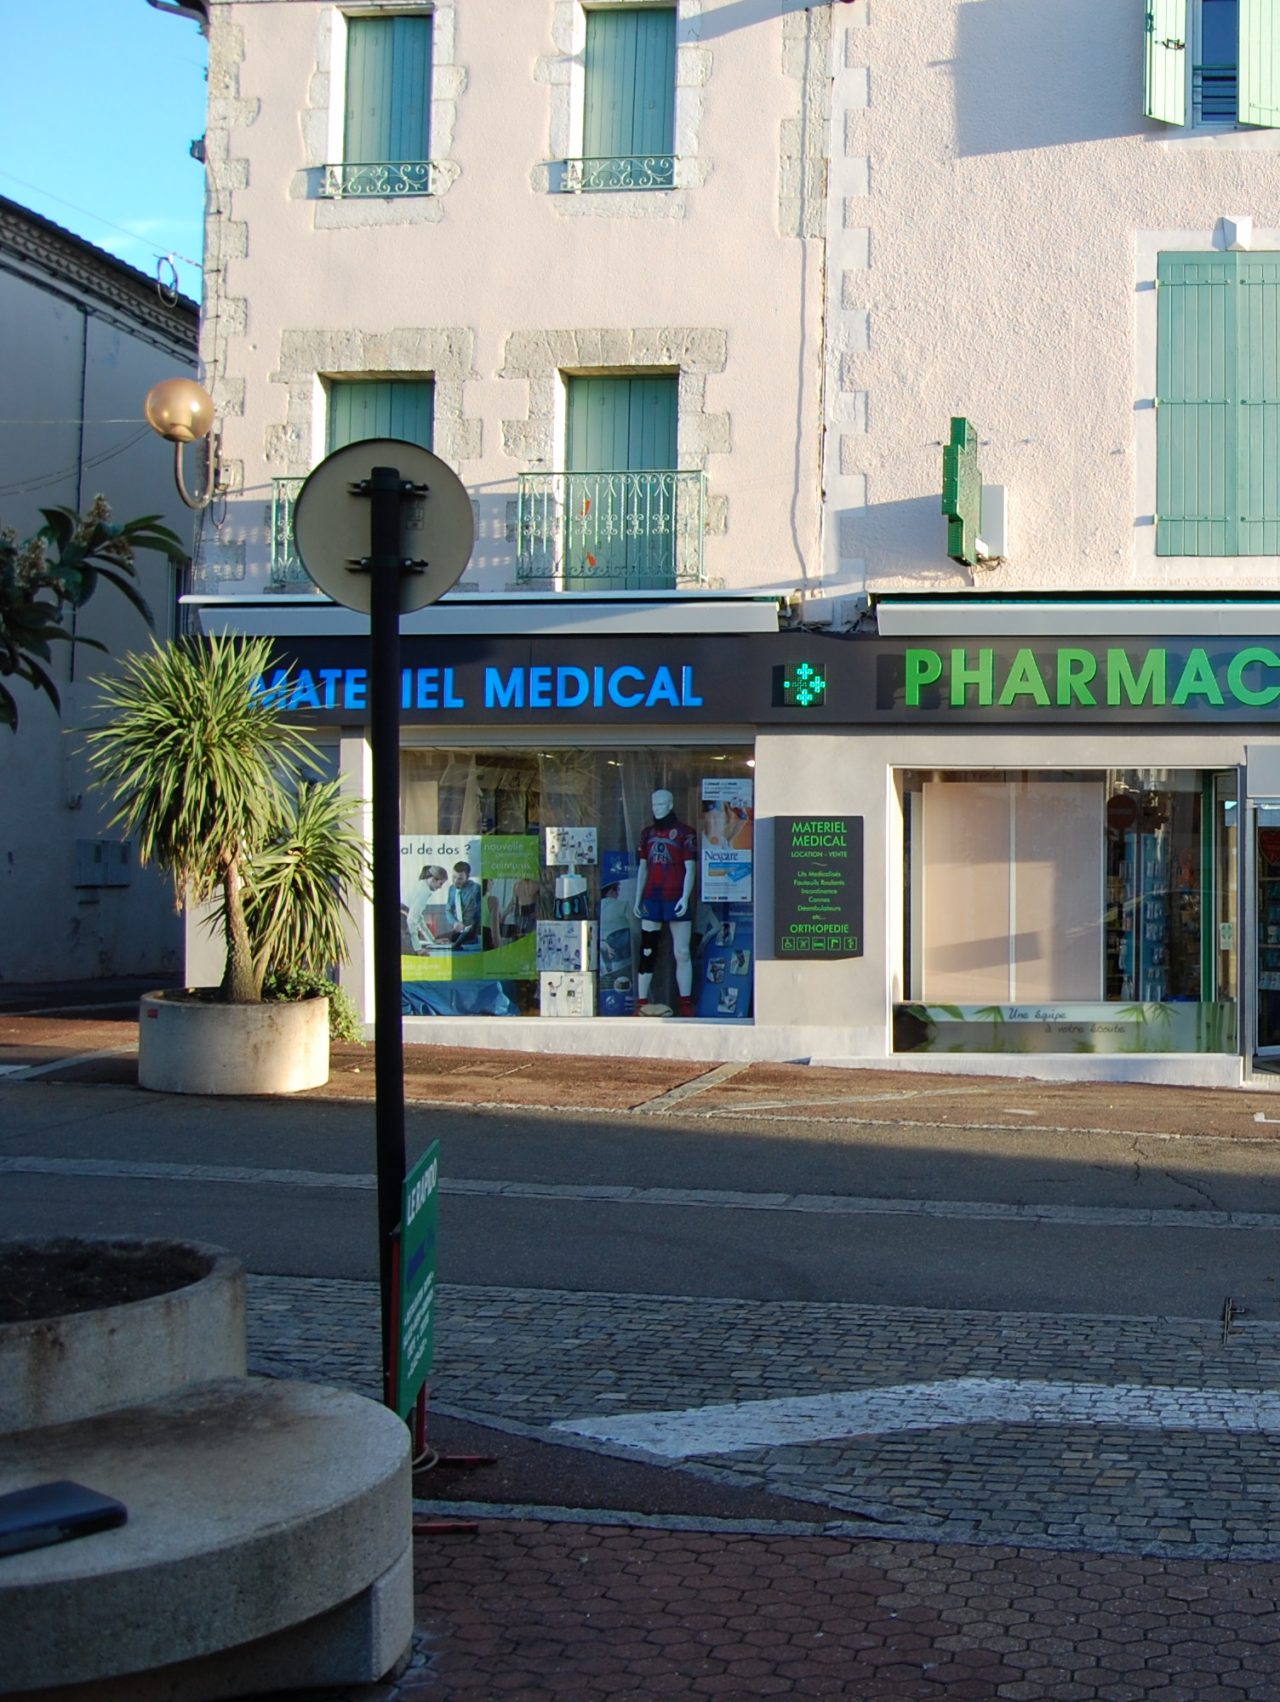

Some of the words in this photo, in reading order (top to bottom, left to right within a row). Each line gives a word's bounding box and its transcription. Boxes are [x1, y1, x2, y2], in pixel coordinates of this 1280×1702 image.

[247, 668, 464, 709] MATEIEL
[484, 665, 703, 708] MEDICAL
[791, 821, 847, 833] MATERIEL
[792, 835, 847, 847] MEDICAL
[401, 843, 413, 855] al
[417, 843, 433, 855] de
[437, 843, 460, 855] dos
[790, 924, 849, 934] ORTHOPEDIE
[1009, 1008, 1029, 1020] Une
[1058, 1023, 1085, 1033] votre
